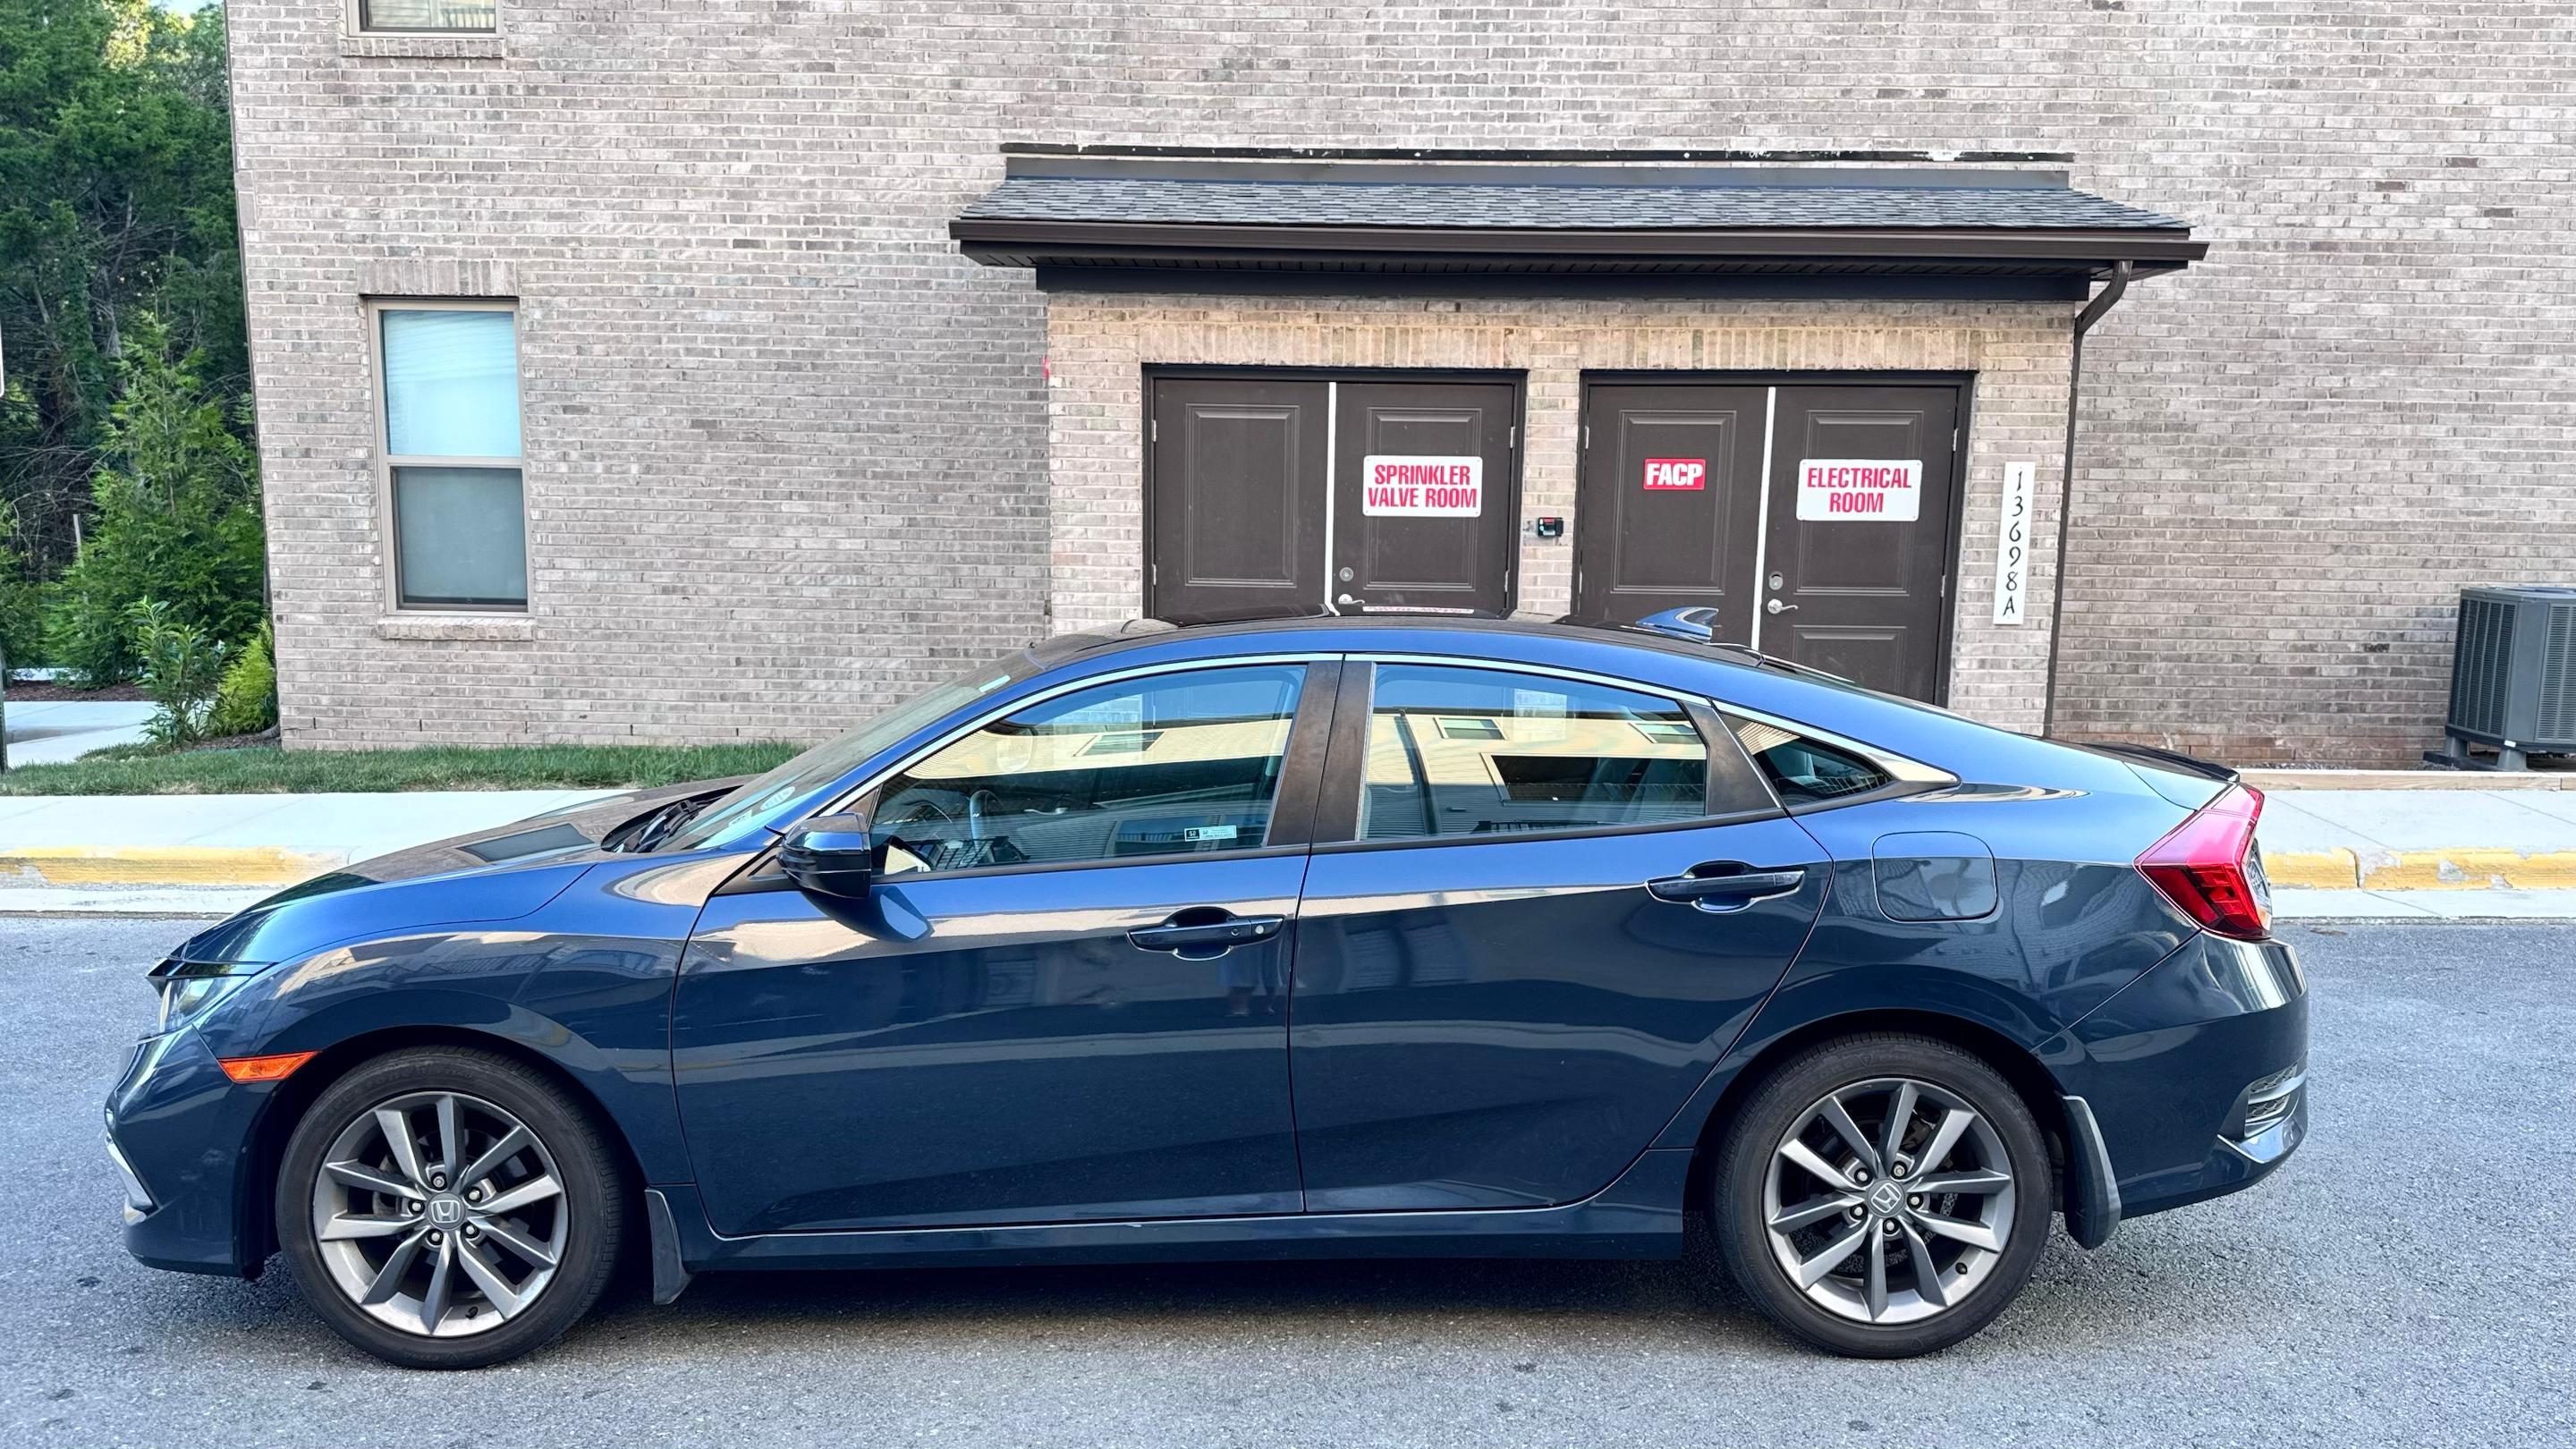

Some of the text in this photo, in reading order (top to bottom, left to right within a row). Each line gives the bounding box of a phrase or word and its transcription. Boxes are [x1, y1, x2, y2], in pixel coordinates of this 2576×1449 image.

[1375, 464, 1470, 485] SPRINKLER
[1647, 462, 1703, 486] FACP
[1808, 468, 1912, 488] ELECTRICAL
[1368, 487, 1477, 508] VALVE ROOM
[1829, 493, 1884, 513] ROOM
[2003, 470, 2023, 615] 13698A
